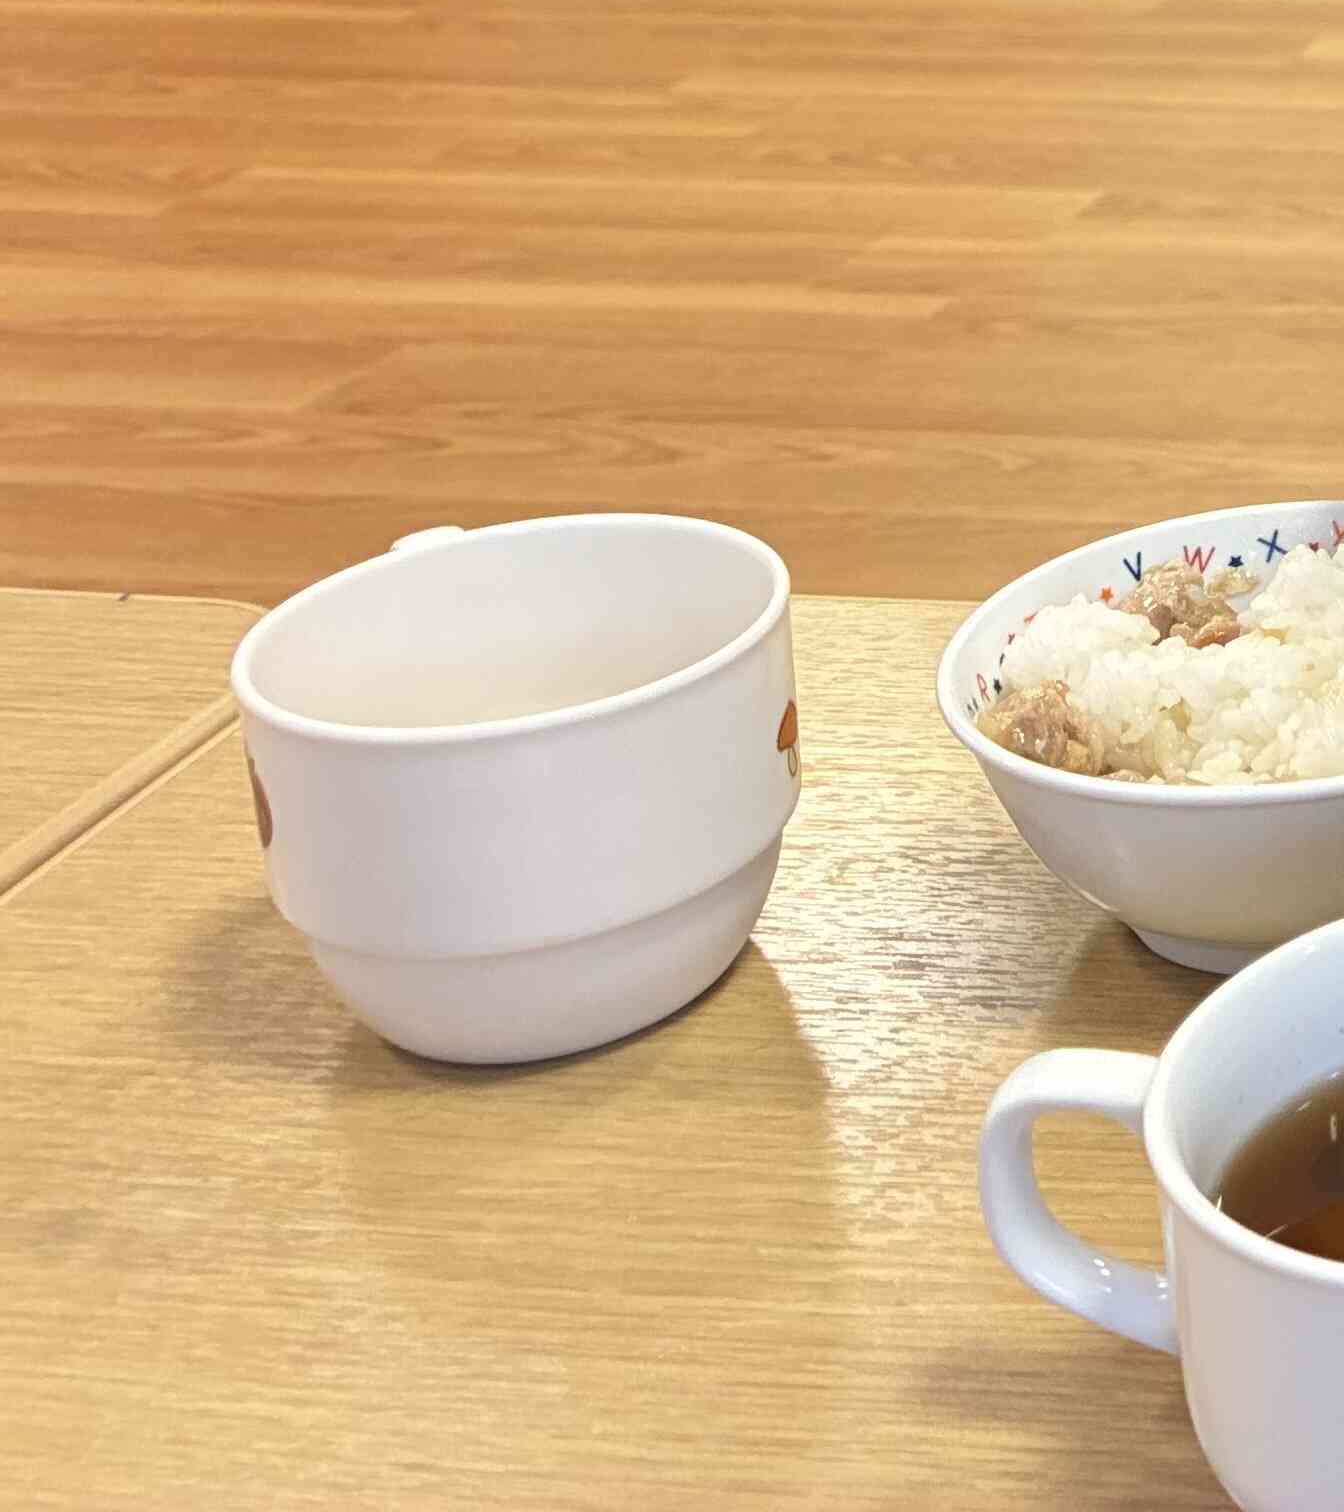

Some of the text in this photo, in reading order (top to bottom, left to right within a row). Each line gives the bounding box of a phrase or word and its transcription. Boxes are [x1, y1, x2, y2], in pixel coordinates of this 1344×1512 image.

[1123, 551, 1142, 582] V
[1183, 544, 1216, 574] W
[1257, 529, 1288, 563] X
